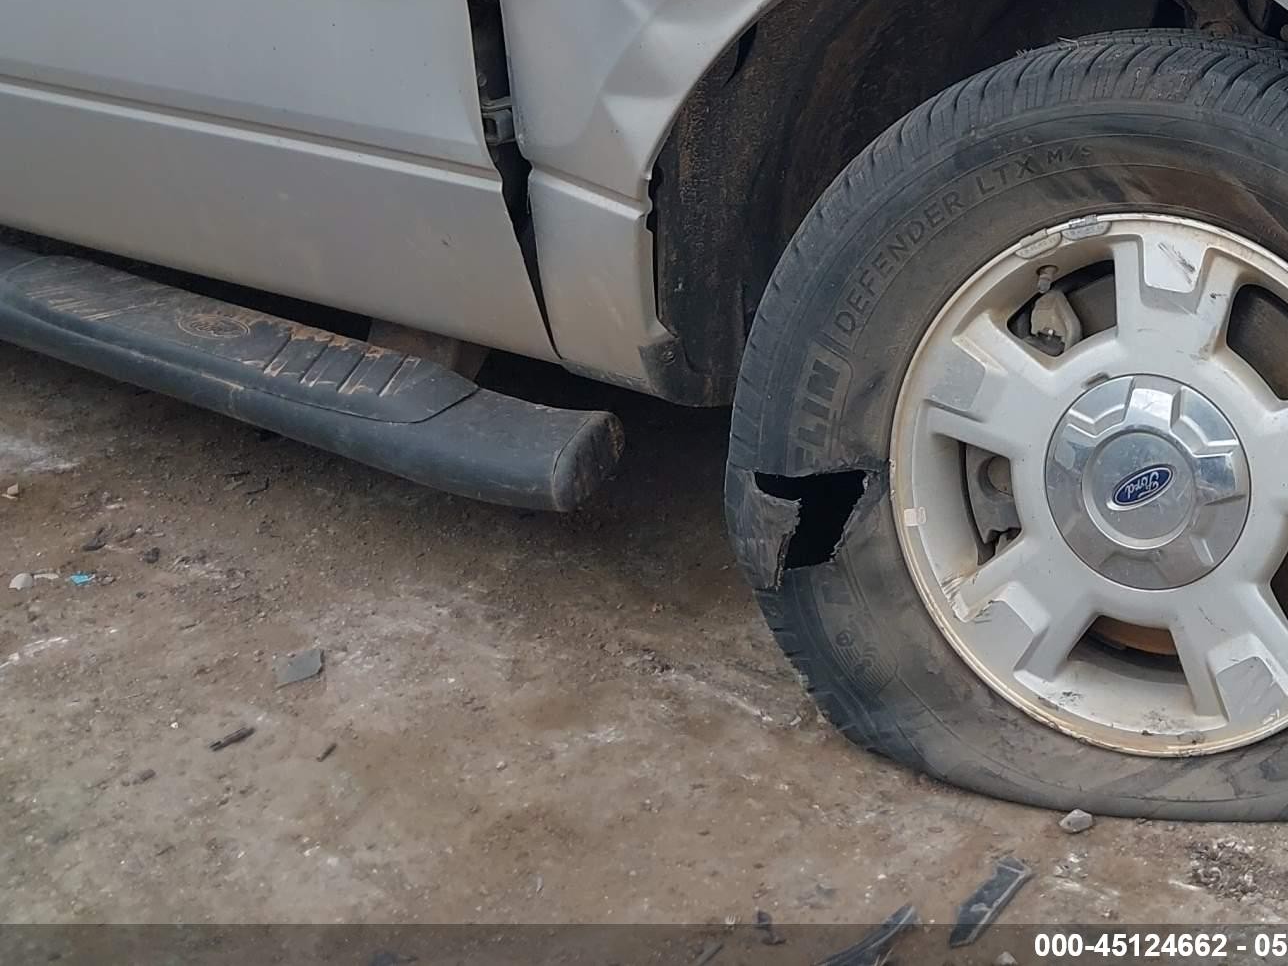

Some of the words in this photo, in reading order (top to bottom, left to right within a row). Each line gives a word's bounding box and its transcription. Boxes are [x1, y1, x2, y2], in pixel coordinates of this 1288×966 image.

[833, 190, 967, 336] DEFENDER
[975, 155, 1035, 196] LTX
[1124, 471, 1160, 500] Ford
